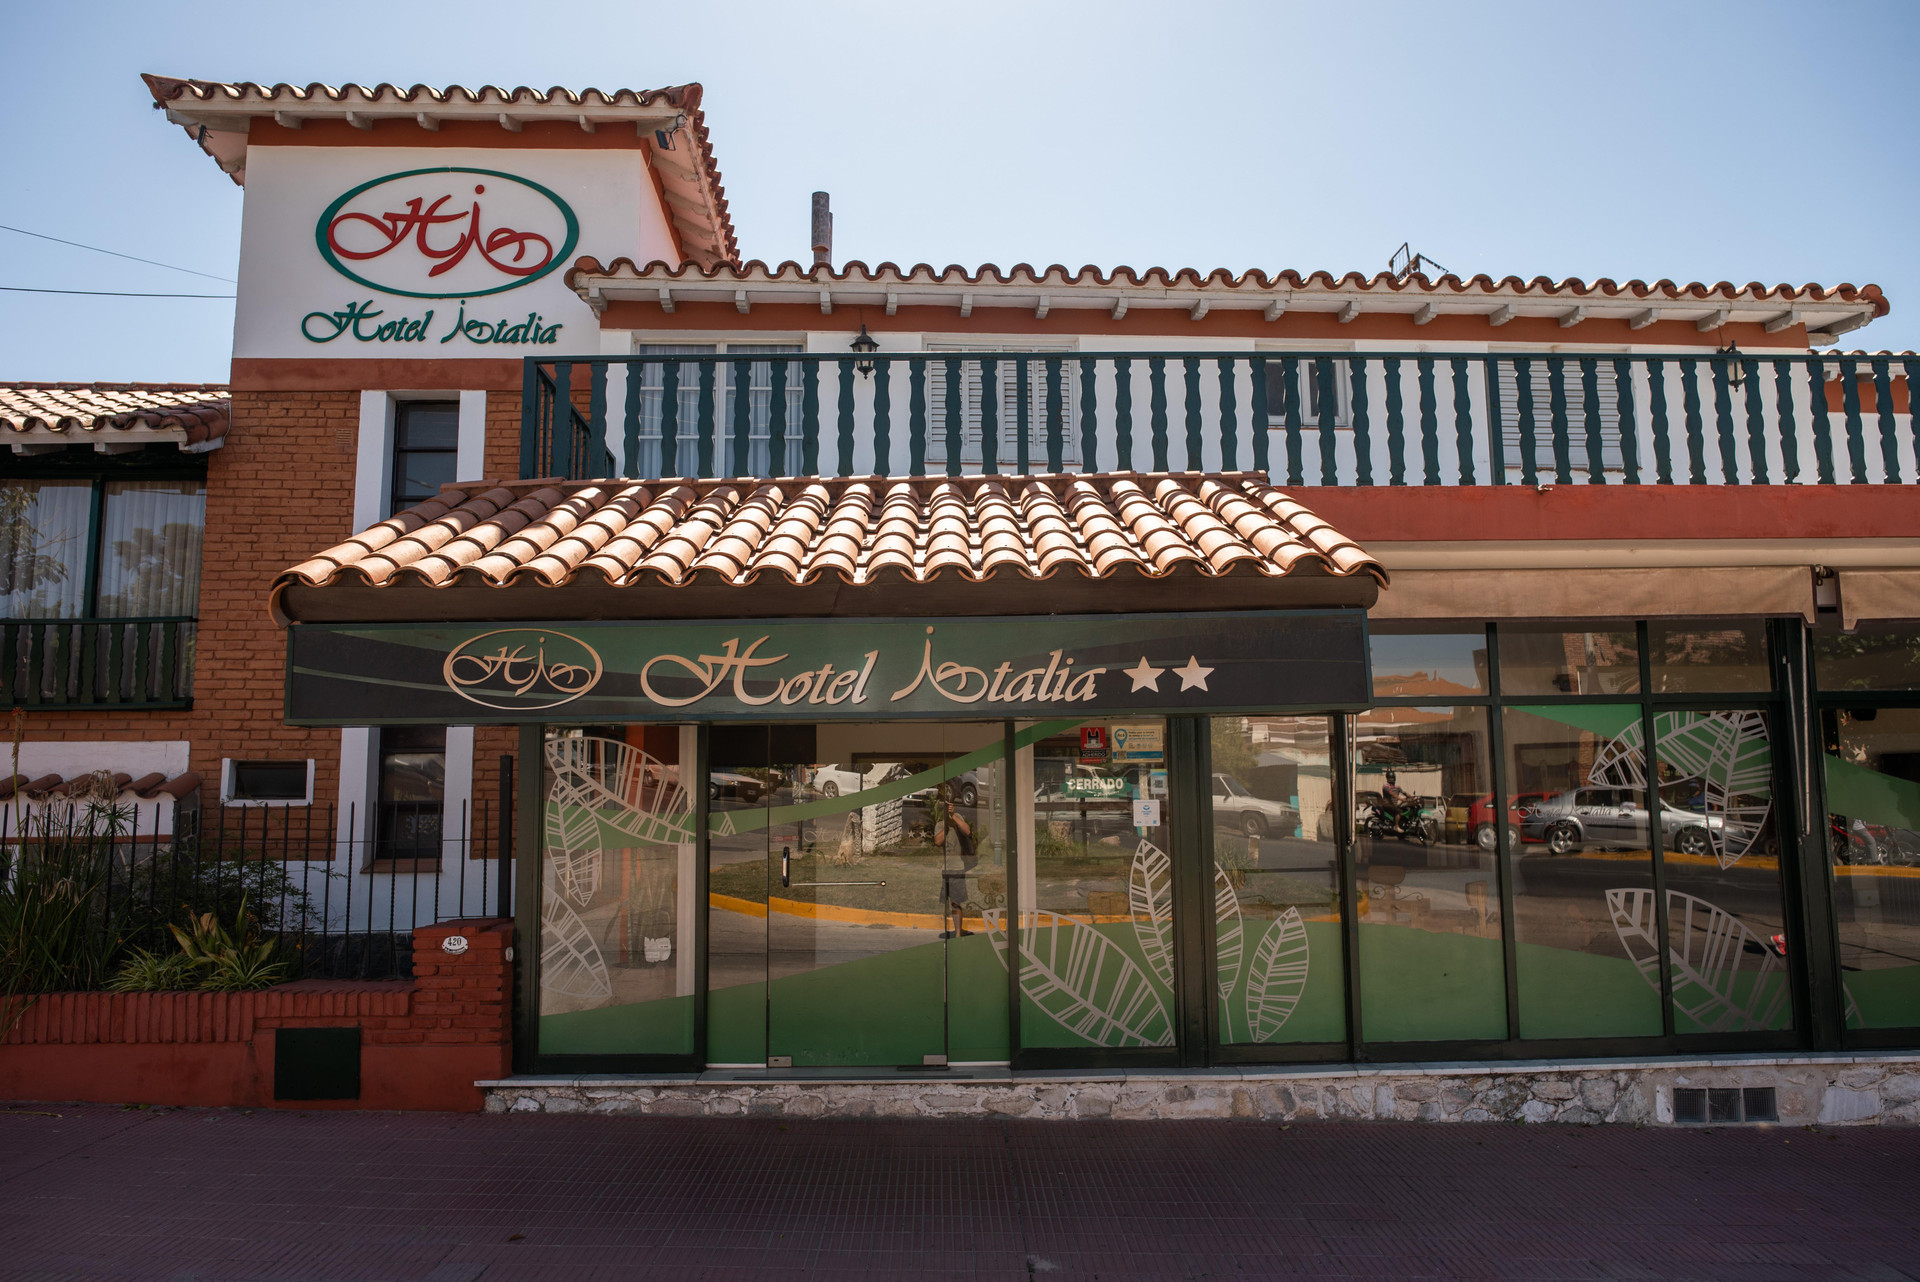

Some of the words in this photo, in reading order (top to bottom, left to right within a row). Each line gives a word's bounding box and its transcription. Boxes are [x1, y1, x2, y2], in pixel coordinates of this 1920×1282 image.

[301, 299, 434, 343] Hotel
[440, 299, 563, 344] Italia
[640, 635, 880, 707] Hotel
[891, 625, 1107, 704] Italia
[1068, 778, 1124, 790] CERRADO
[447, 937, 462, 946] 420
